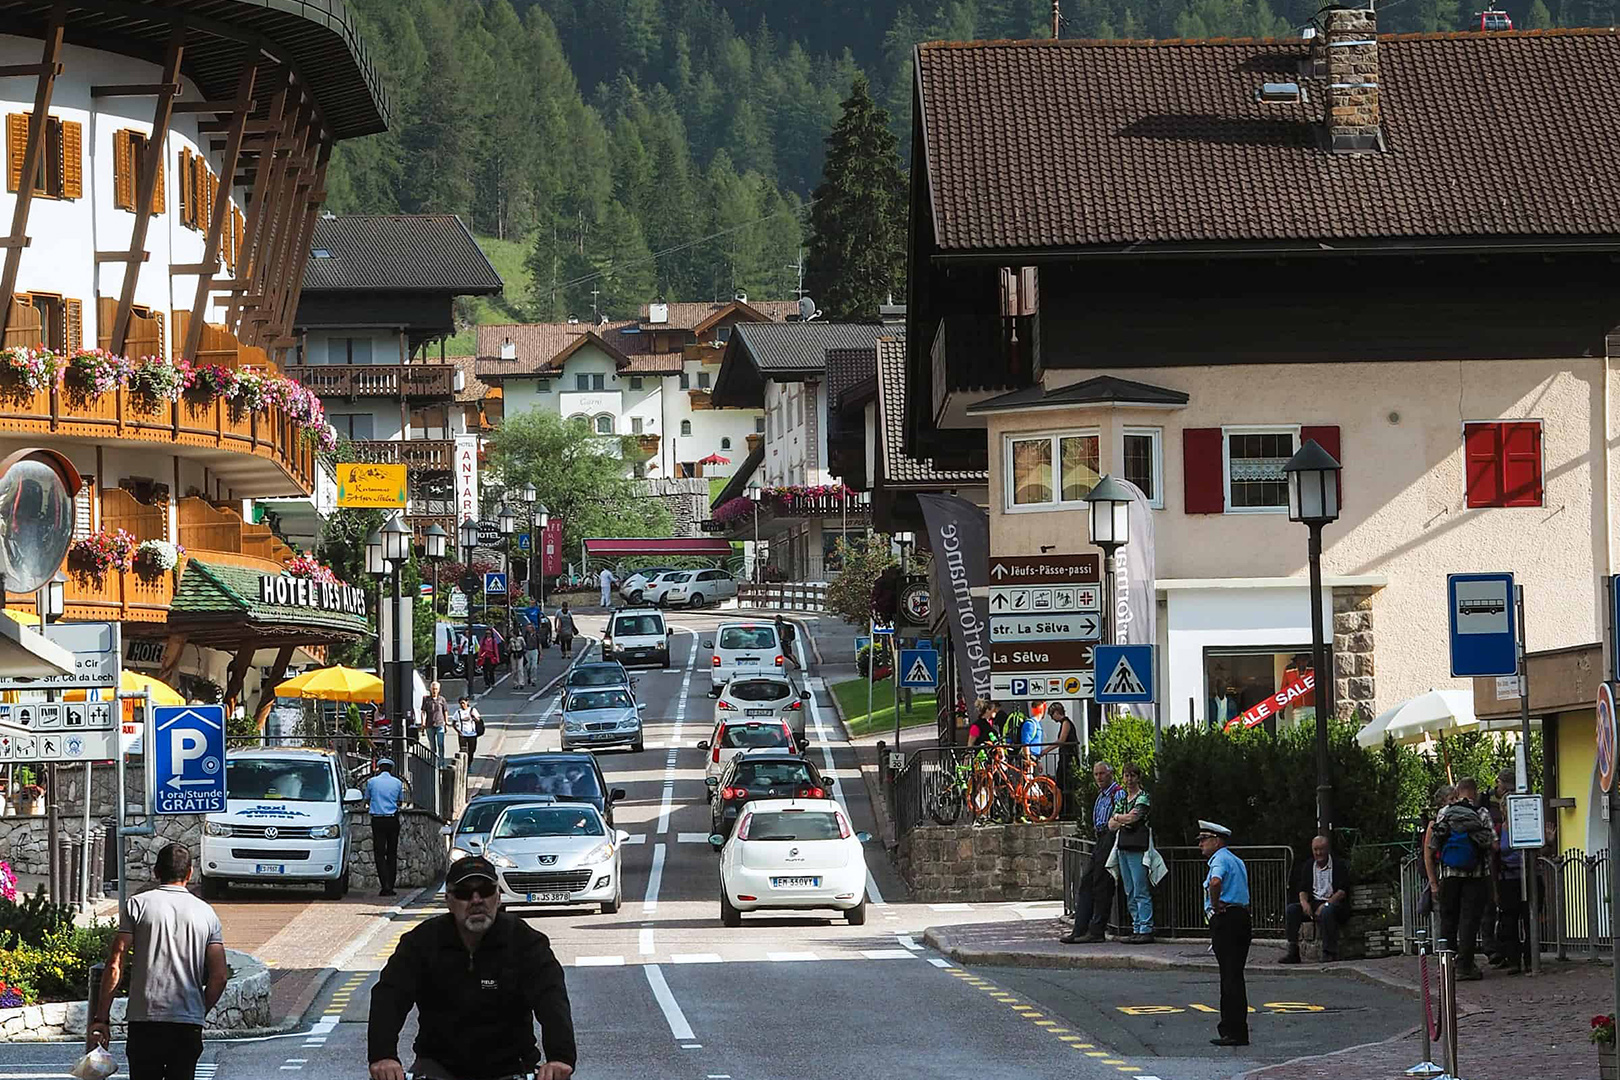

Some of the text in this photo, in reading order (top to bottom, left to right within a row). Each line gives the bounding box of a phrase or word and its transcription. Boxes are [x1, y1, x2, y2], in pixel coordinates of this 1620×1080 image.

[263, 575, 366, 616] HOTEL DES ALPES
[993, 622, 1070, 635] str. La Sëlva
[85, 660, 98, 668] Cir
[993, 653, 1008, 664] La
[79, 674, 90, 682] da
[1275, 675, 1316, 707] SALE
[122, 726, 135, 735] AXI
[171, 728, 208, 775] P
[159, 790, 223, 800] 1 ora/Stunde
[162, 798, 220, 811] GRATIS
